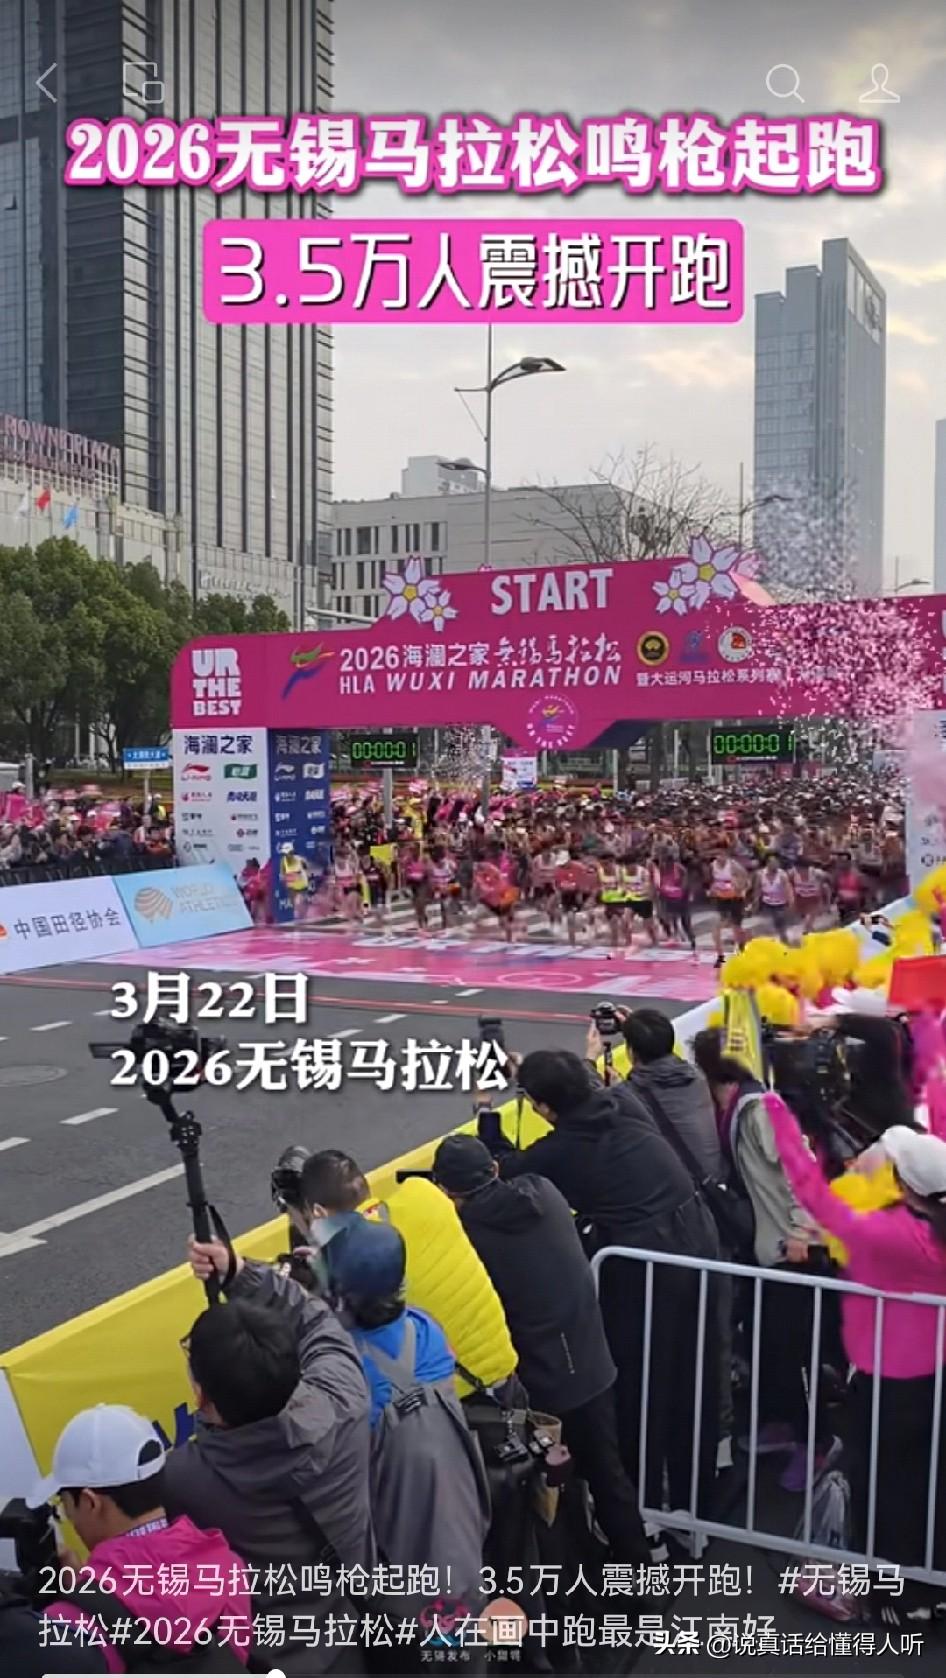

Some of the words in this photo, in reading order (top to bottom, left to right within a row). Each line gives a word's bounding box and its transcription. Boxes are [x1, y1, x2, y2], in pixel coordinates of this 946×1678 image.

[490, 568, 614, 616] START
[191, 647, 241, 677] UR
[340, 642, 491, 672] 2026海澜之家
[192, 677, 242, 698] THE
[340, 675, 375, 694] HLA
[387, 671, 455, 693] WUXI
[468, 665, 622, 690] MARATHON
[193, 700, 242, 716] BEST
[184, 735, 253, 754] 海澜之家
[352, 741, 416, 760] 00:00:01
[714, 734, 793, 754] 00:00:01
[13, 907, 121, 941] 中国田径协会
